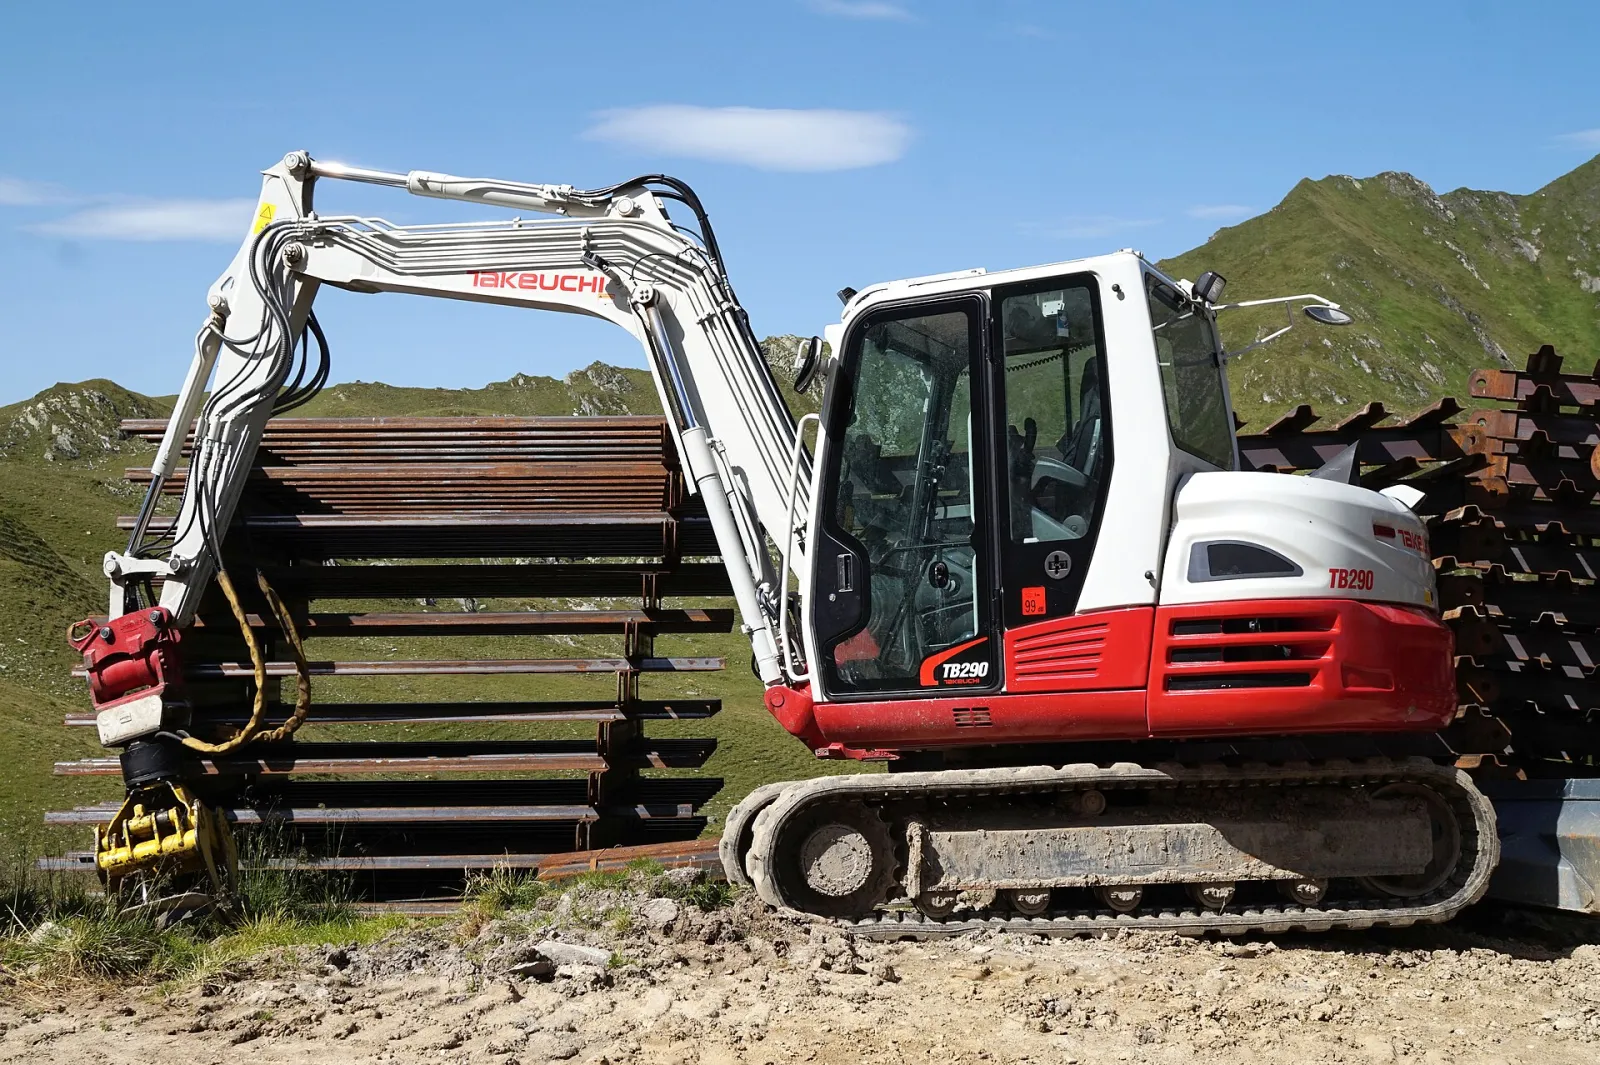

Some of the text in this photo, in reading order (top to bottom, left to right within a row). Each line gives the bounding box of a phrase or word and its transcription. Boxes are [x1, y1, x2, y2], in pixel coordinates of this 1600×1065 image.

[1328, 568, 1374, 590] TB290
[1025, 600, 1036, 612] 99
[942, 662, 989, 678] TB290
